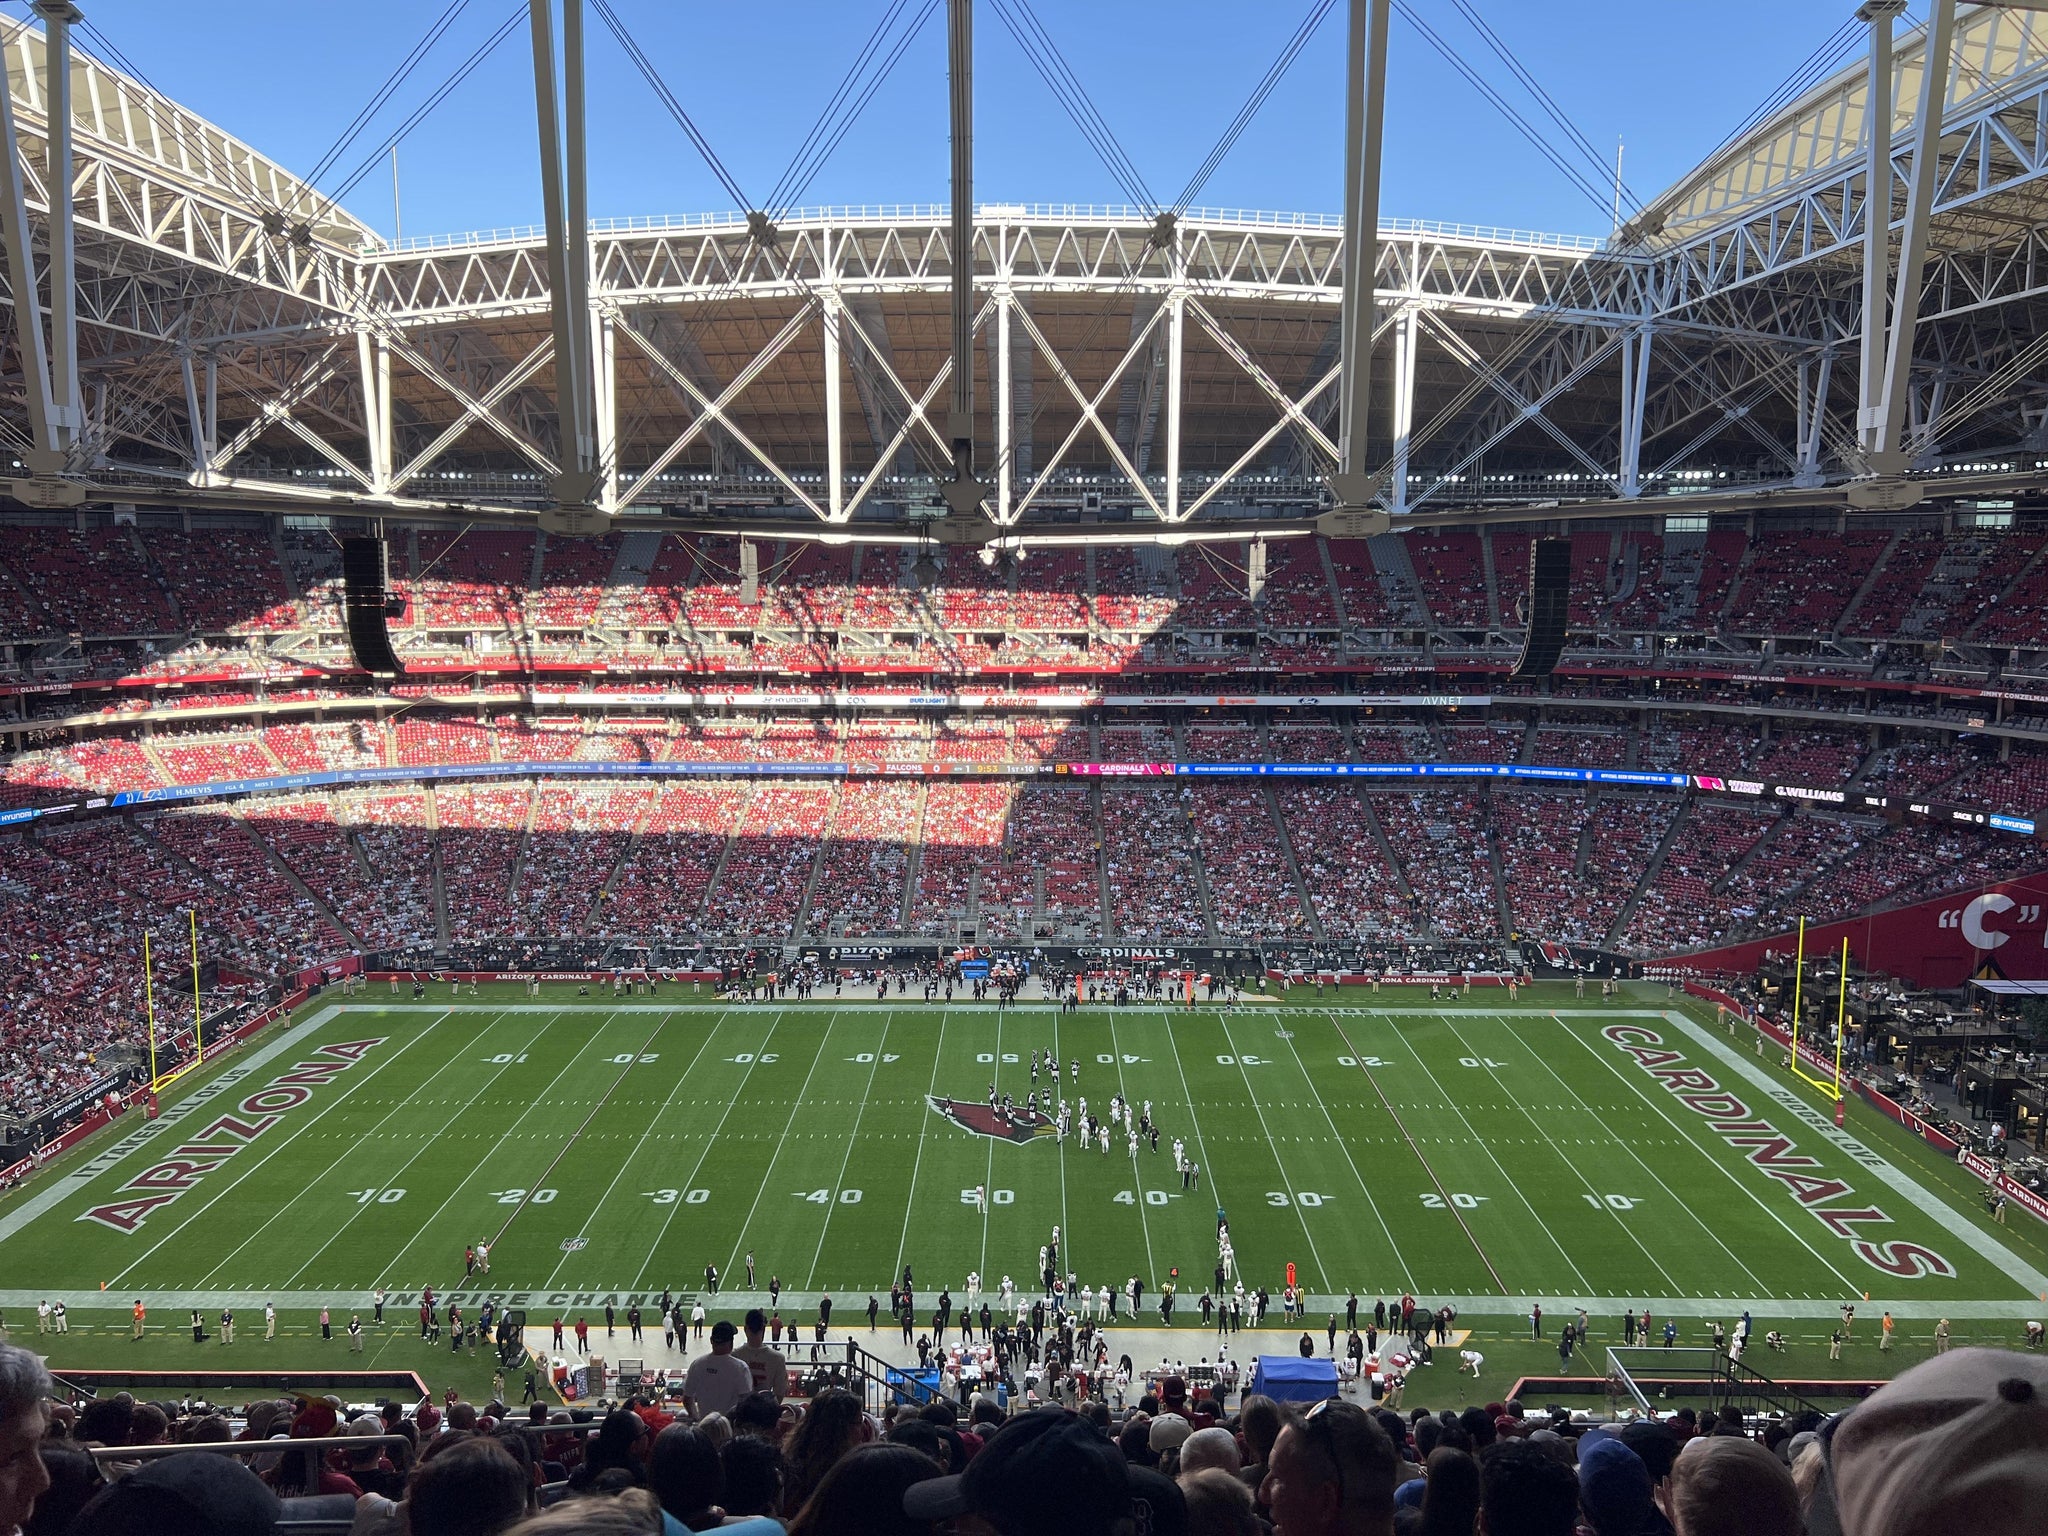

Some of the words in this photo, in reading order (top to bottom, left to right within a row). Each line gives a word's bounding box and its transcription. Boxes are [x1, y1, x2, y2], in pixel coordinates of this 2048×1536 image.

[20, 685, 42, 693] OLLIE
[43, 683, 73, 691] MATSON
[1980, 690, 2003, 698] JIMMY
[1422, 697, 1463, 705] AVNET
[977, 765, 998, 773] 9:53
[1025, 765, 1035, 773] 10
[1083, 765, 1089, 773] 3
[176, 786, 212, 796] H.MEVIS
[1775, 786, 1845, 803] G.WILLIAMS
[1953, 811, 1972, 821] SACK
[1, 811, 32, 821] HYUNDAI
[2002, 820, 2034, 831] HYUNDAI
[830, 946, 893, 954] ARIZON
[1077, 948, 1176, 958] CRDINALS
[203, 1035, 236, 1060] CARDINALS
[1788, 1040, 1815, 1063] AIZONA
[52, 1099, 83, 1120] ARIZONA
[84, 1076, 120, 1101] CARDINALS
[72, 1163, 102, 1178] IT
[97, 1122, 167, 1164] TAKES
[166, 1098, 205, 1121] ALL
[199, 1083, 228, 1101] OF
[225, 1068, 251, 1083] US
[1768, 1089, 1839, 1133] CHOOSE
[1830, 1135, 1887, 1168] LOVE
[73, 1036, 390, 1235] ARIZONA
[14, 1141, 62, 1176] CARNALS
[1600, 1024, 1957, 1279] CARDINALS
[1965, 1156, 2004, 1187] ARIZOA
[356, 1188, 408, 1203] 10
[497, 1188, 560, 1204] 20
[652, 1188, 711, 1204] 30
[805, 1188, 863, 1204] 40
[960, 1188, 1015, 1204] 50
[1112, 1190, 1169, 1205] 40
[1265, 1191, 1323, 1207] 30
[1419, 1192, 1479, 1209] 20
[1581, 1193, 1634, 1210] 10
